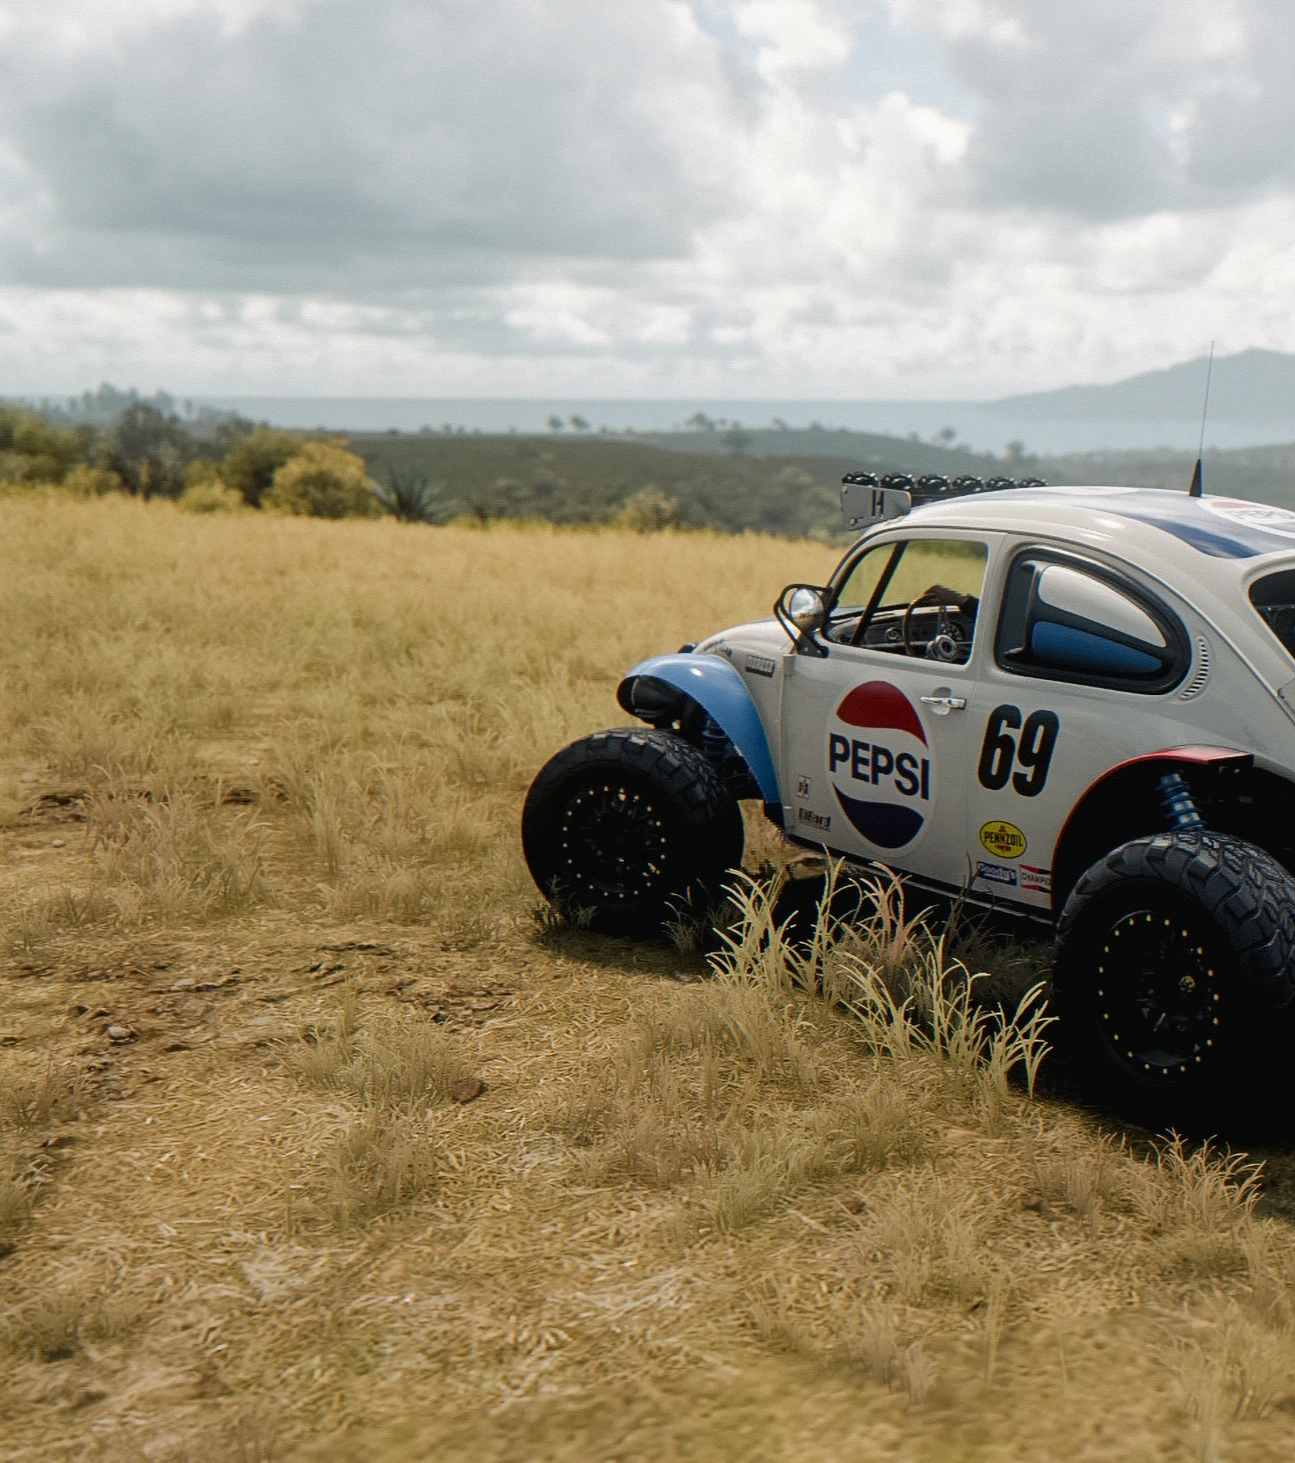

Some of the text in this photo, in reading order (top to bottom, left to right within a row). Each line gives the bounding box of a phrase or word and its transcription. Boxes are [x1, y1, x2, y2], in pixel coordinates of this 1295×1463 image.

[829, 733, 930, 800] PEPSI
[978, 704, 1060, 798] 69
[984, 831, 1024, 847] PENNZOIL
